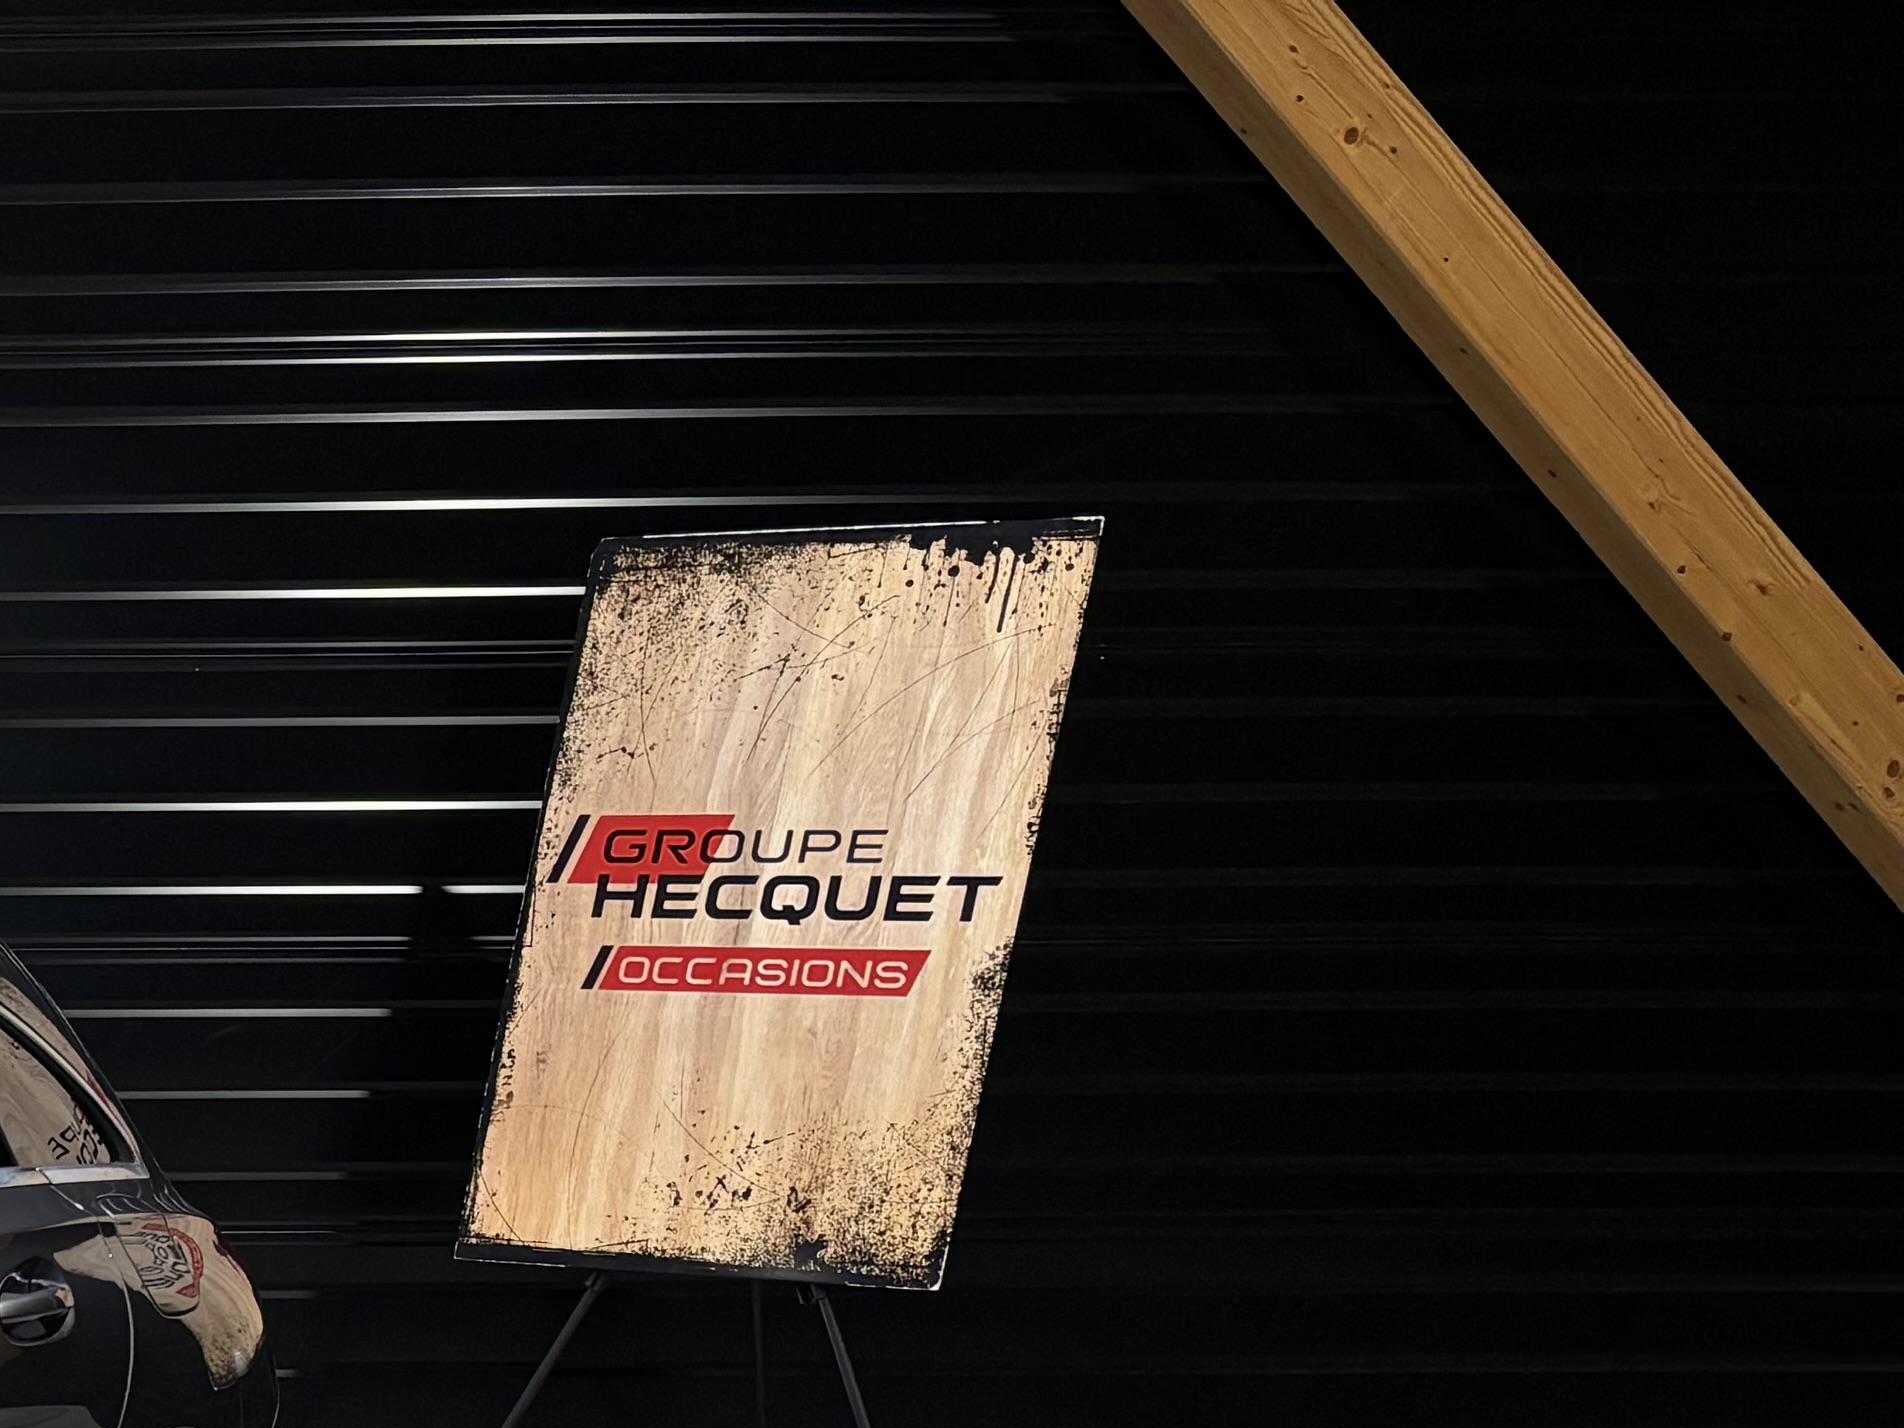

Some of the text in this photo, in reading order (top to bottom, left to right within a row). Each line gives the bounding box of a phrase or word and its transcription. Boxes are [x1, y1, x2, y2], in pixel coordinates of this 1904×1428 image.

[602, 829, 889, 864] GROUPE
[591, 875, 1003, 925] HECQUET
[618, 955, 909, 989] OCCASIONS
